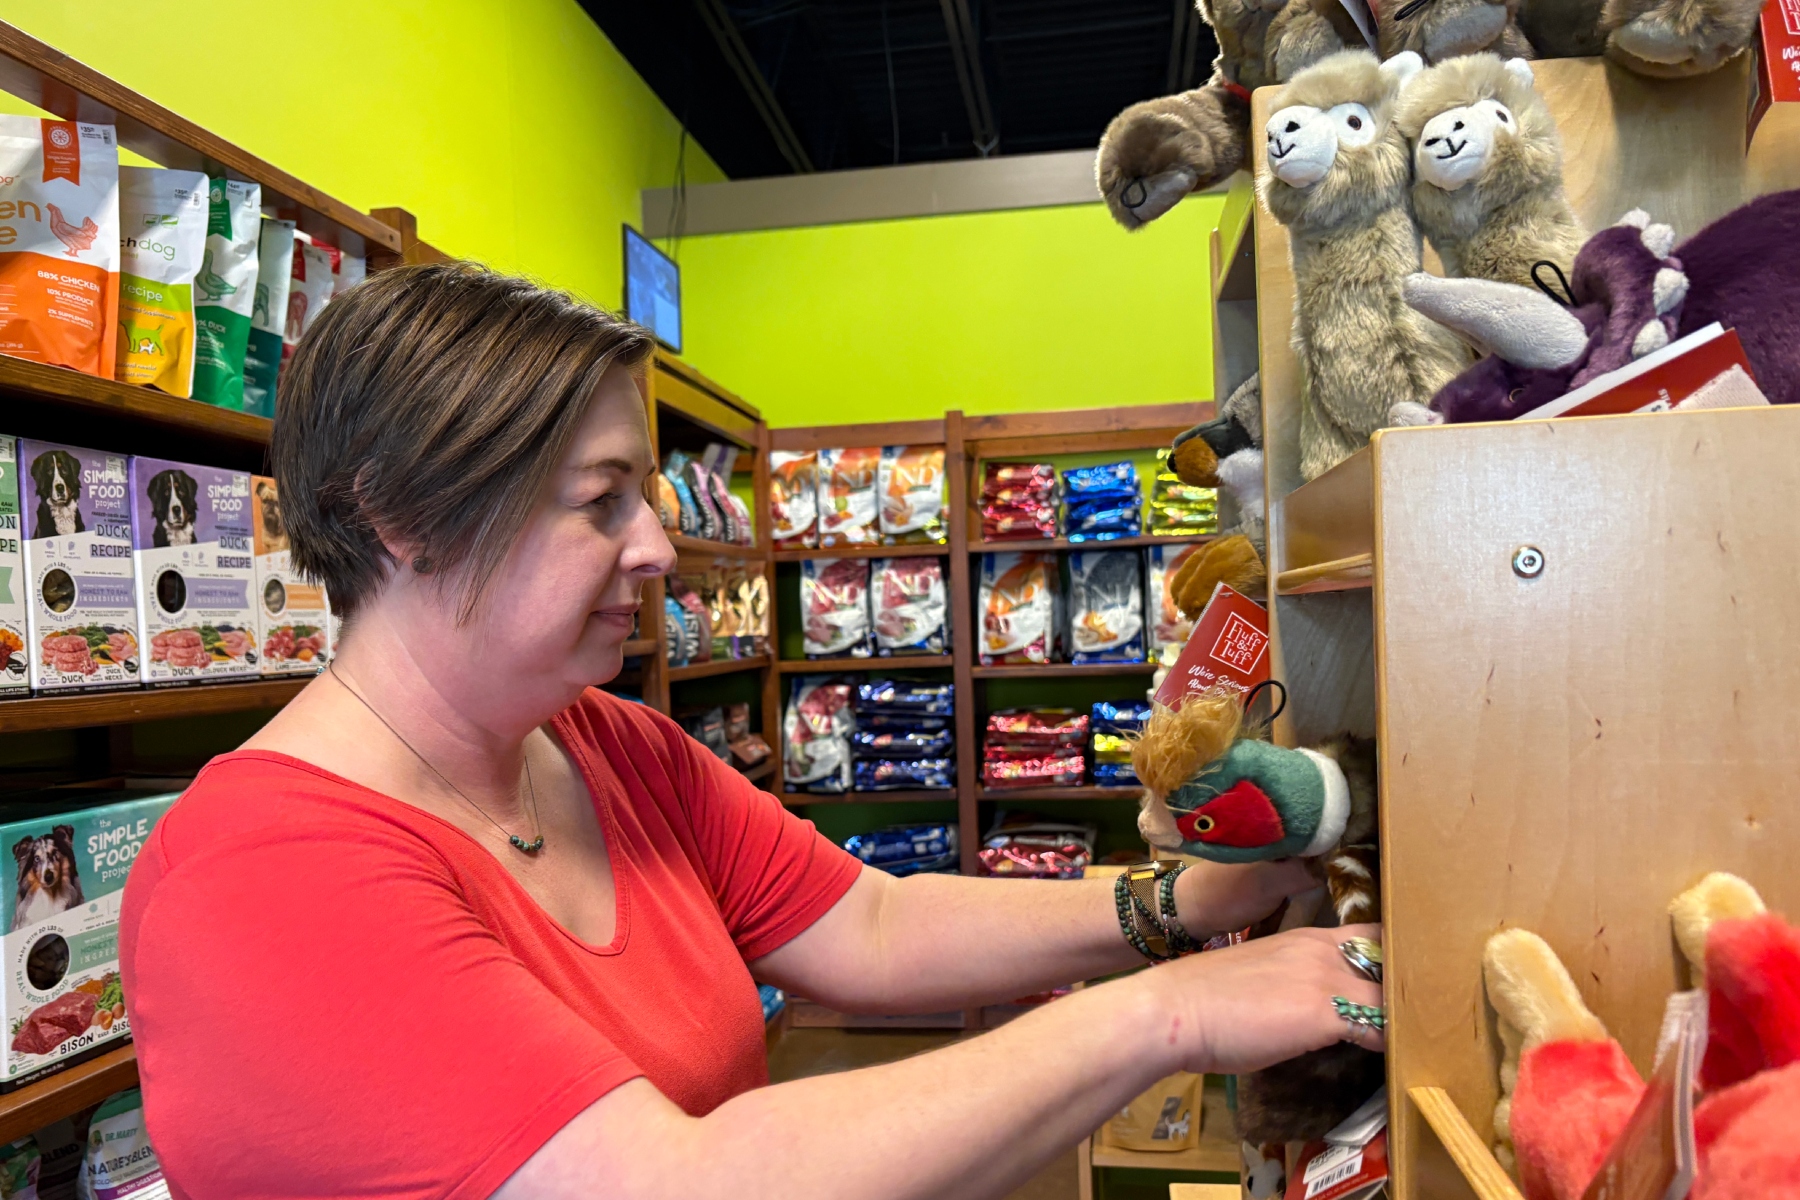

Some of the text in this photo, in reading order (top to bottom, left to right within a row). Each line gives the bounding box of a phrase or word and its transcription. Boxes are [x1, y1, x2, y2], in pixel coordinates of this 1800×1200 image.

[37, 270, 59, 281] 88%
[60, 275, 100, 293] CHICKEN
[46, 287, 61, 297] 10%
[62, 291, 94, 307] PRODUCE
[123, 283, 163, 302] recipe
[57, 310, 94, 328] SUPPLEMENTS
[208, 321, 226, 334] DUCK
[88, 485, 125, 498] FOOD
[95, 499, 121, 509] project
[212, 498, 243, 512] FOOD
[96, 524, 129, 538] DUCK
[90, 543, 132, 558] RECIPE
[220, 536, 248, 550] DUCK
[217, 555, 252, 568] RECIPE
[1225, 620, 1261, 652] Fluff
[1220, 639, 1253, 665] Tuff
[1236, 639, 1248, 652] &
[61, 674, 85, 684] DUCK
[172, 667, 195, 677] DUCK
[1188, 664, 1251, 692] We're Serious
[1187, 678, 1212, 692] About
[99, 819, 112, 828] the
[87, 818, 149, 854] SIMPLE
[93, 841, 142, 873] FOOD
[17, 945, 27, 964] MADE
[26, 931, 38, 945] WITH
[38, 926, 46, 934] 20
[25, 991, 50, 1004] WHOLE
[51, 978, 69, 1000] FOOD
[60, 1032, 94, 1055] BISON
